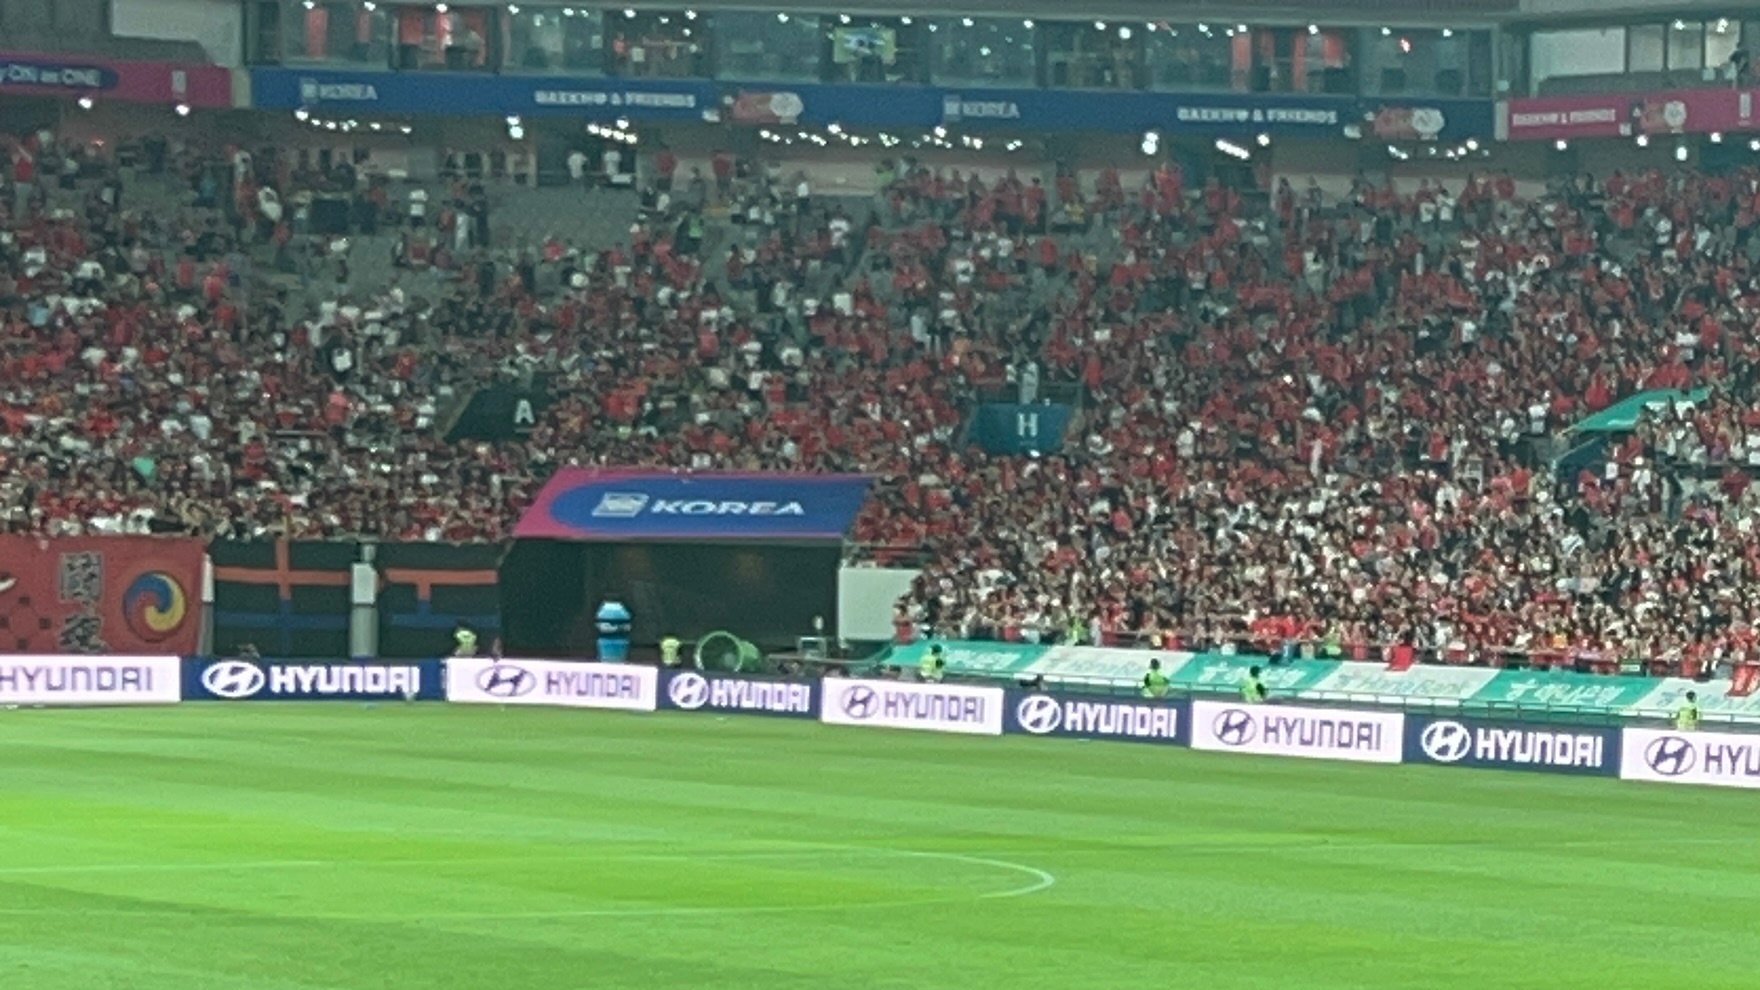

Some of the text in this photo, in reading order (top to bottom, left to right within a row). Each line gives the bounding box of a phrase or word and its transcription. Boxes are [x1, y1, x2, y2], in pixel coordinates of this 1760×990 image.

[514, 399, 536, 424] A
[1017, 412, 1038, 437] H
[652, 499, 805, 516] KOREA
[0, 666, 152, 692] HYUNDAI
[270, 666, 420, 693] HYUNDAI
[545, 671, 641, 700] HYUNDAI
[711, 678, 810, 712] HYUNDAI
[884, 687, 985, 724] HYUNDAI
[1064, 701, 1177, 738] HYUNDAI
[1263, 715, 1381, 751] HYUNDAI
[1475, 727, 1603, 767] HYUNDAI
